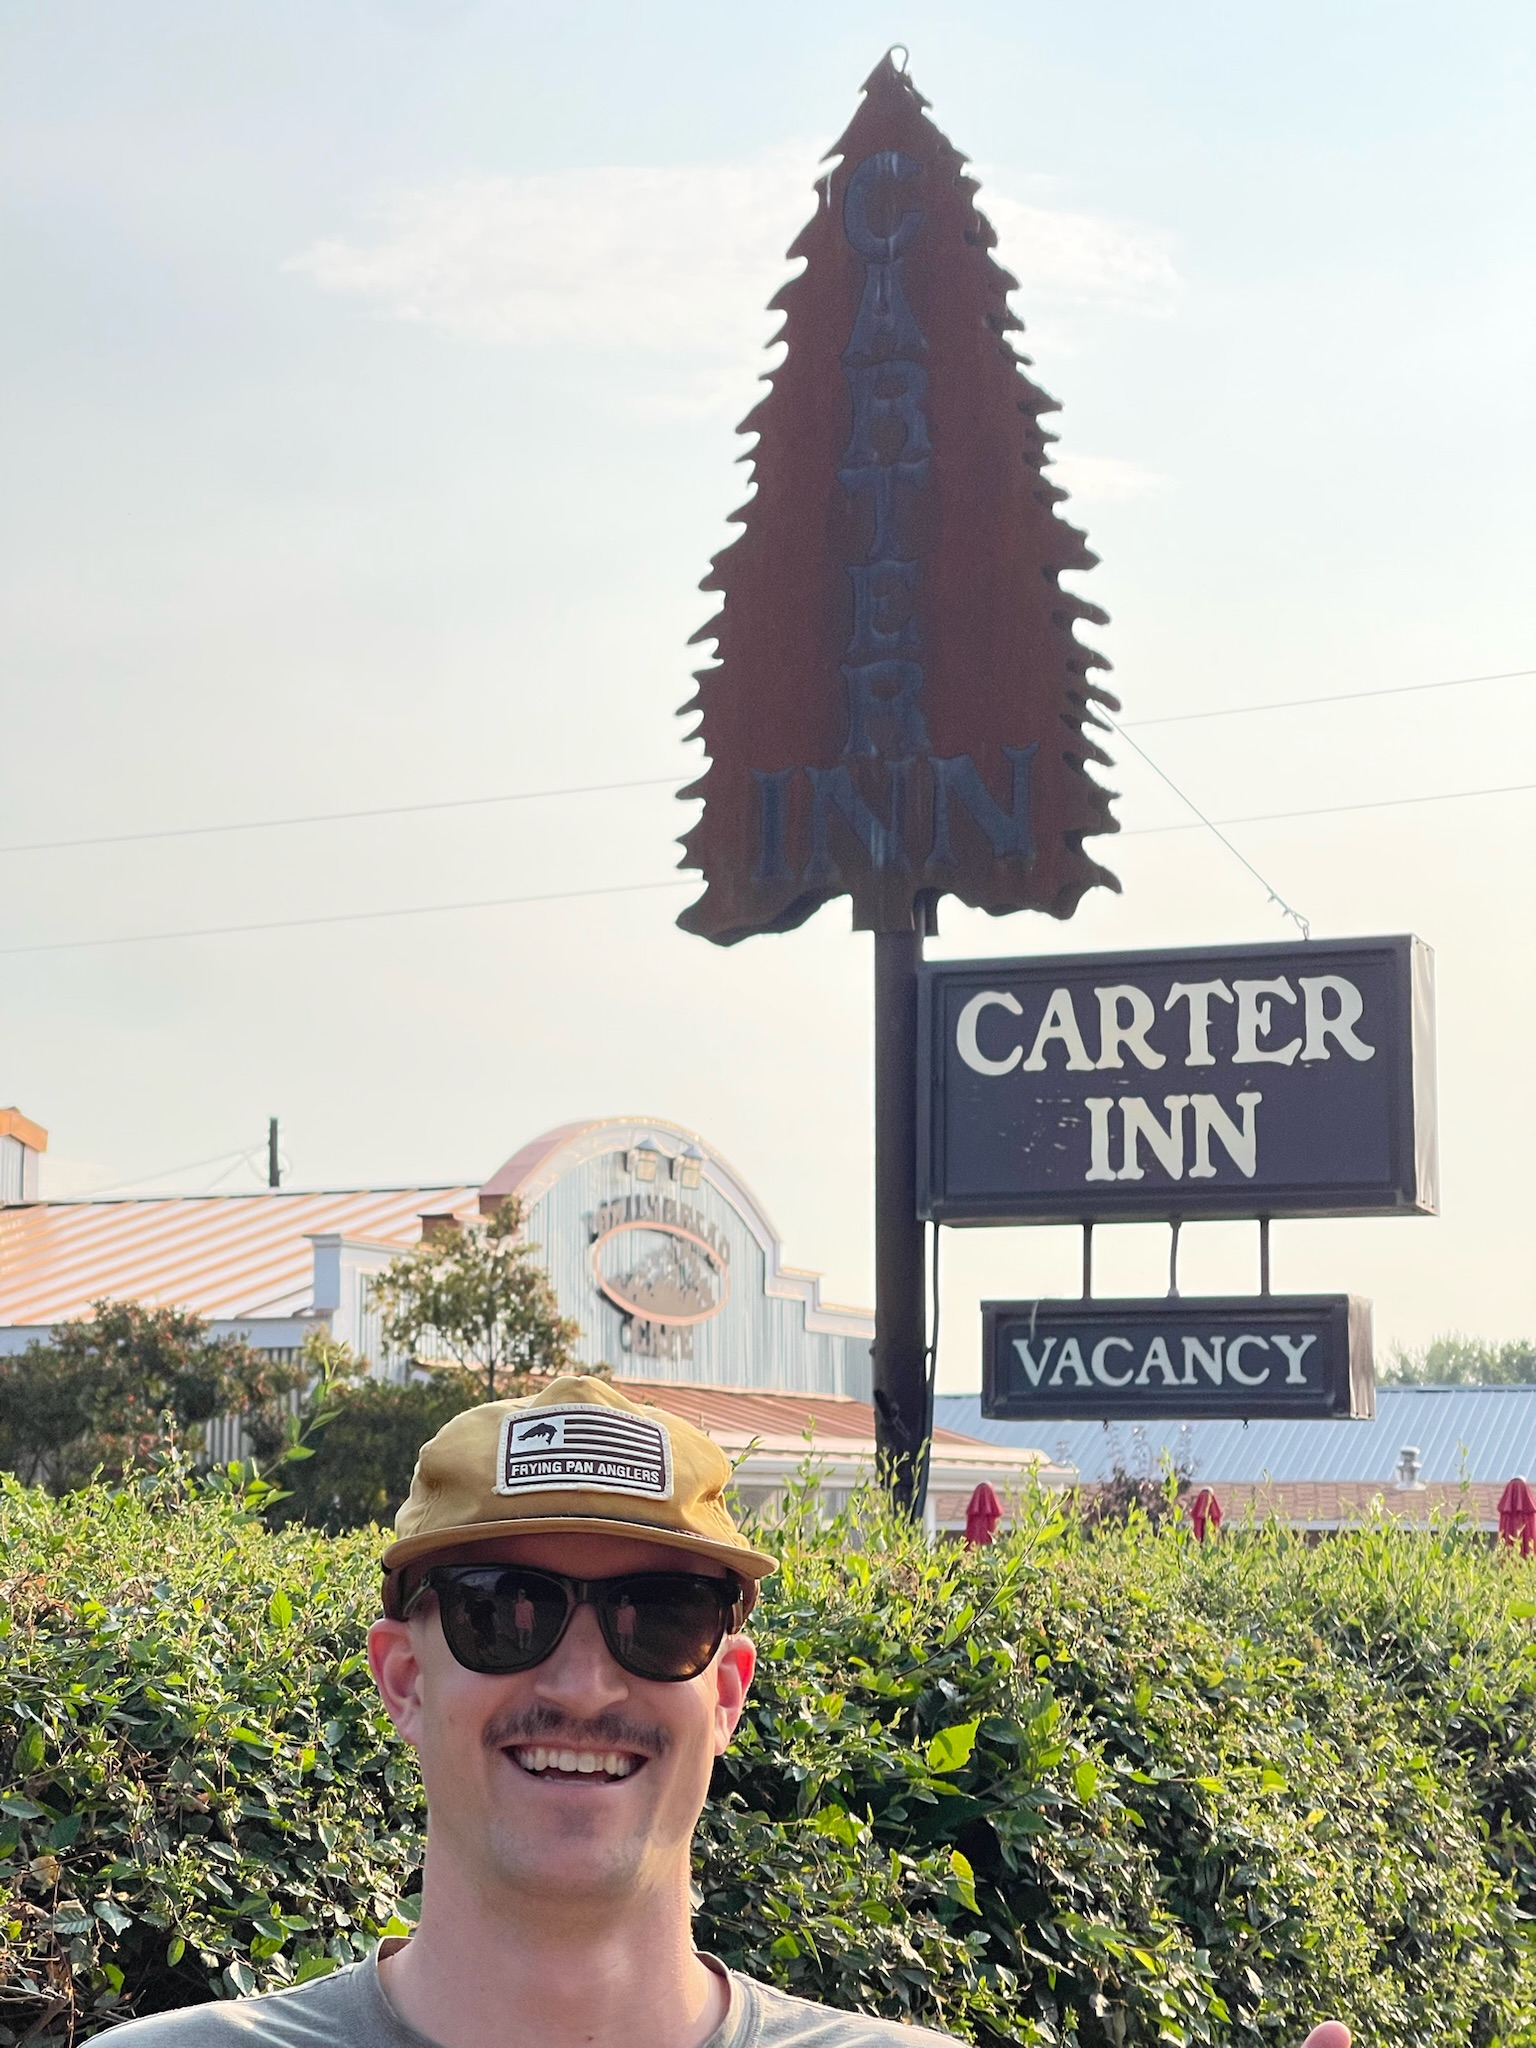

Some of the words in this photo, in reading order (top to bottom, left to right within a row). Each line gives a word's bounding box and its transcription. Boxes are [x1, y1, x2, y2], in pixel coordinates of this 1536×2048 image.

[836, 150, 932, 756] CARTER
[751, 742, 1039, 880] INN
[956, 975, 1376, 1076] CARTER
[1085, 1092, 1263, 1181] INN
[1012, 1334, 1317, 1387] VACANCY
[511, 1461, 562, 1477] FRYING
[566, 1460, 594, 1474] PAN
[598, 1464, 660, 1483] ANGLERS
